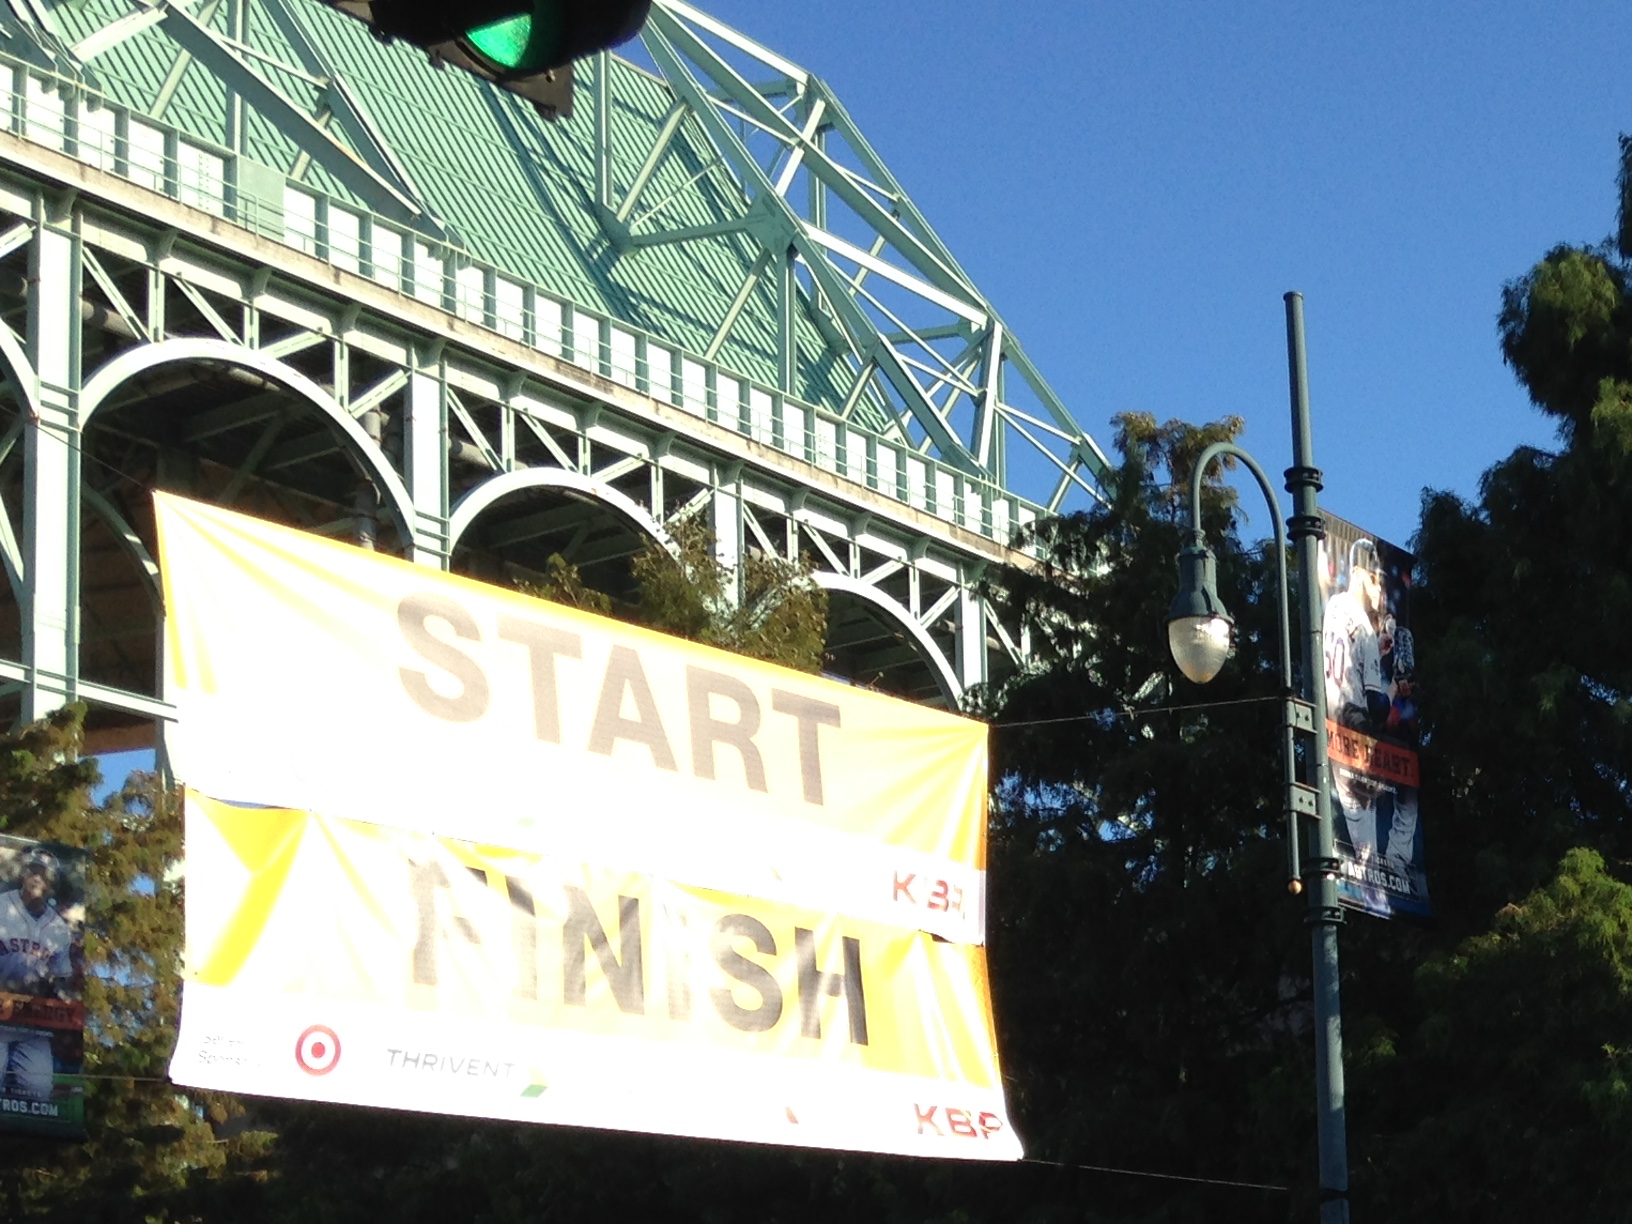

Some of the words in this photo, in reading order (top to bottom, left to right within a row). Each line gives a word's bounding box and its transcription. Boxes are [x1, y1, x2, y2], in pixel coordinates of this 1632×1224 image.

[397, 592, 841, 806] START
[1348, 861, 1411, 895] ASTROS.COM
[409, 857, 868, 1046] FINISH
[387, 1049, 516, 1079] THRIVENT
